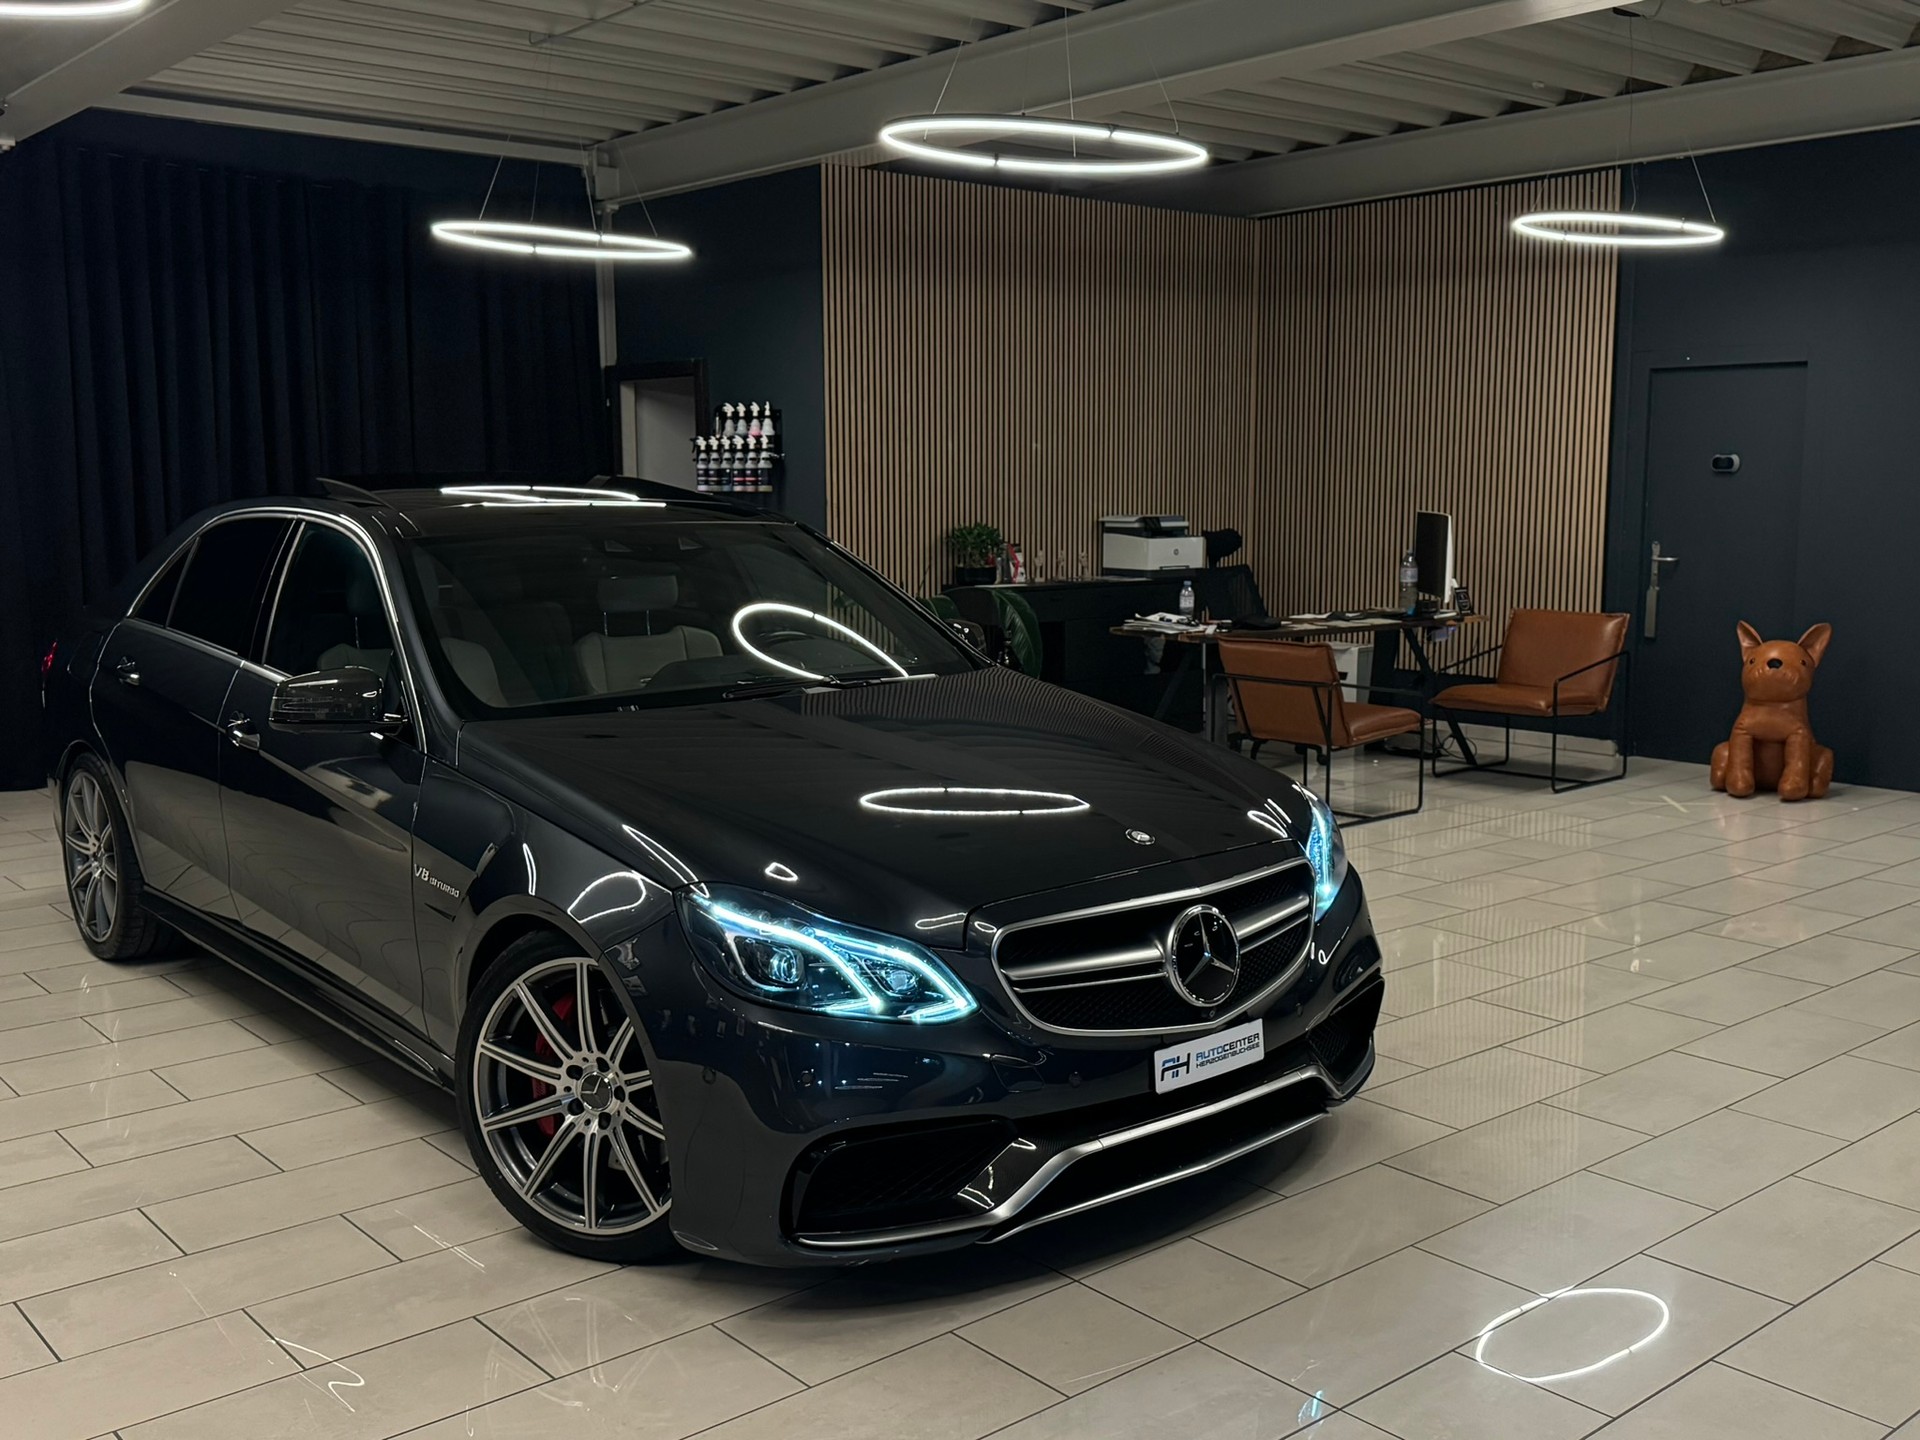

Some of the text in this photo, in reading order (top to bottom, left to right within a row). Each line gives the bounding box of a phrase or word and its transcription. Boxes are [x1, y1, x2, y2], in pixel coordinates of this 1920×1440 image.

[414, 863, 429, 881] V8
[1195, 1032, 1260, 1062] AUTOCENTER
[1195, 1041, 1260, 1069] HERZOGENBUCHSEE
